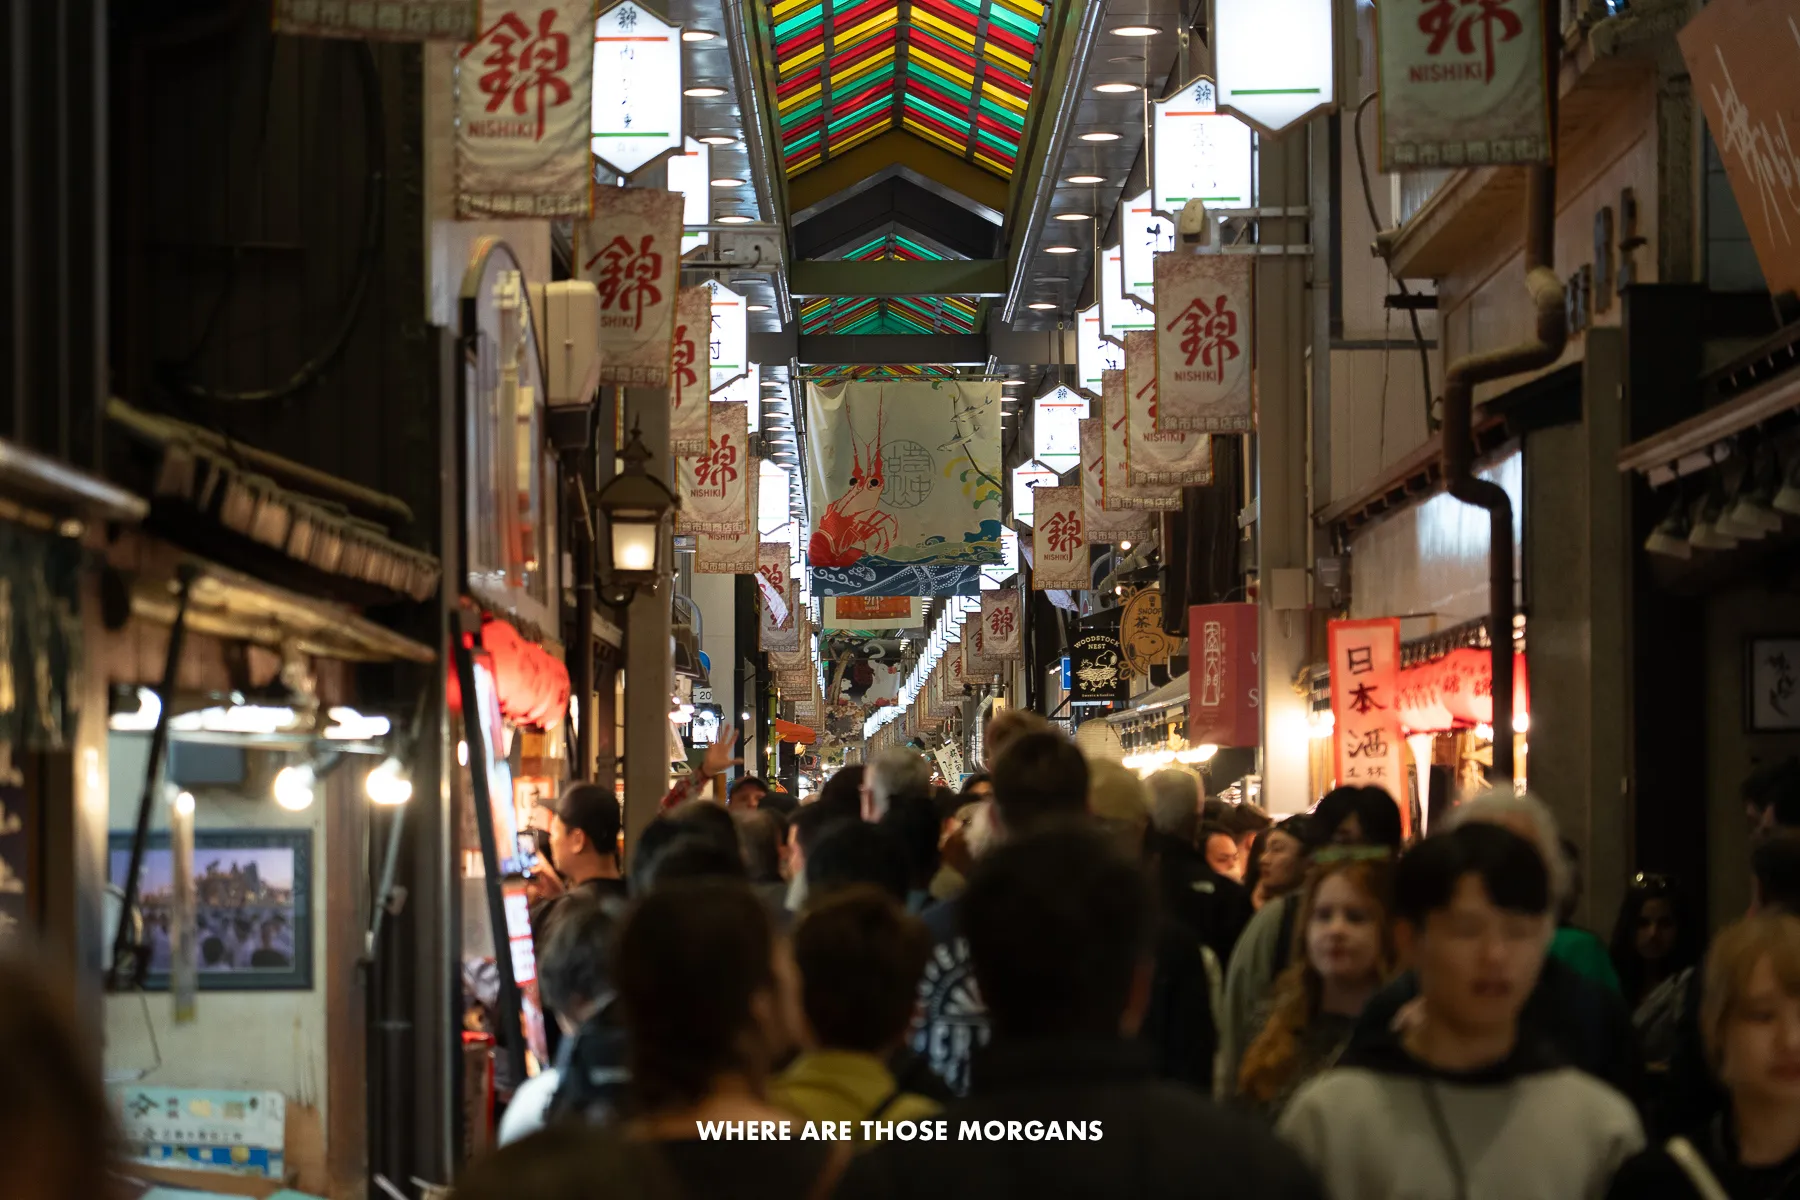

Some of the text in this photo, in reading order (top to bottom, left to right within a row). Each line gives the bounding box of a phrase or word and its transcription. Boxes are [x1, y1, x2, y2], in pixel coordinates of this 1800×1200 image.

[459, 8, 572, 143] 錦
[1410, 62, 1482, 83] NISHIKI
[468, 120, 534, 138] NISHIKI
[585, 235, 662, 332] 錦
[600, 316, 634, 329] SHIKI
[1166, 294, 1240, 385] 錦
[1175, 371, 1217, 381] NISHIKI
[1143, 432, 1181, 442] NISHIKI
[690, 489, 721, 498] NISHIKI
[708, 533, 736, 541] NISHIKI
[1040, 510, 1084, 563] 錦
[1043, 553, 1069, 561] NISHIKI
[1138, 607, 1163, 615] SNOOP
[986, 606, 1014, 642] 錦
[1073, 635, 1120, 649] WOODSTOCK
[699, 691, 712, 700] 20
[1347, 646, 1388, 758] 日本酒
